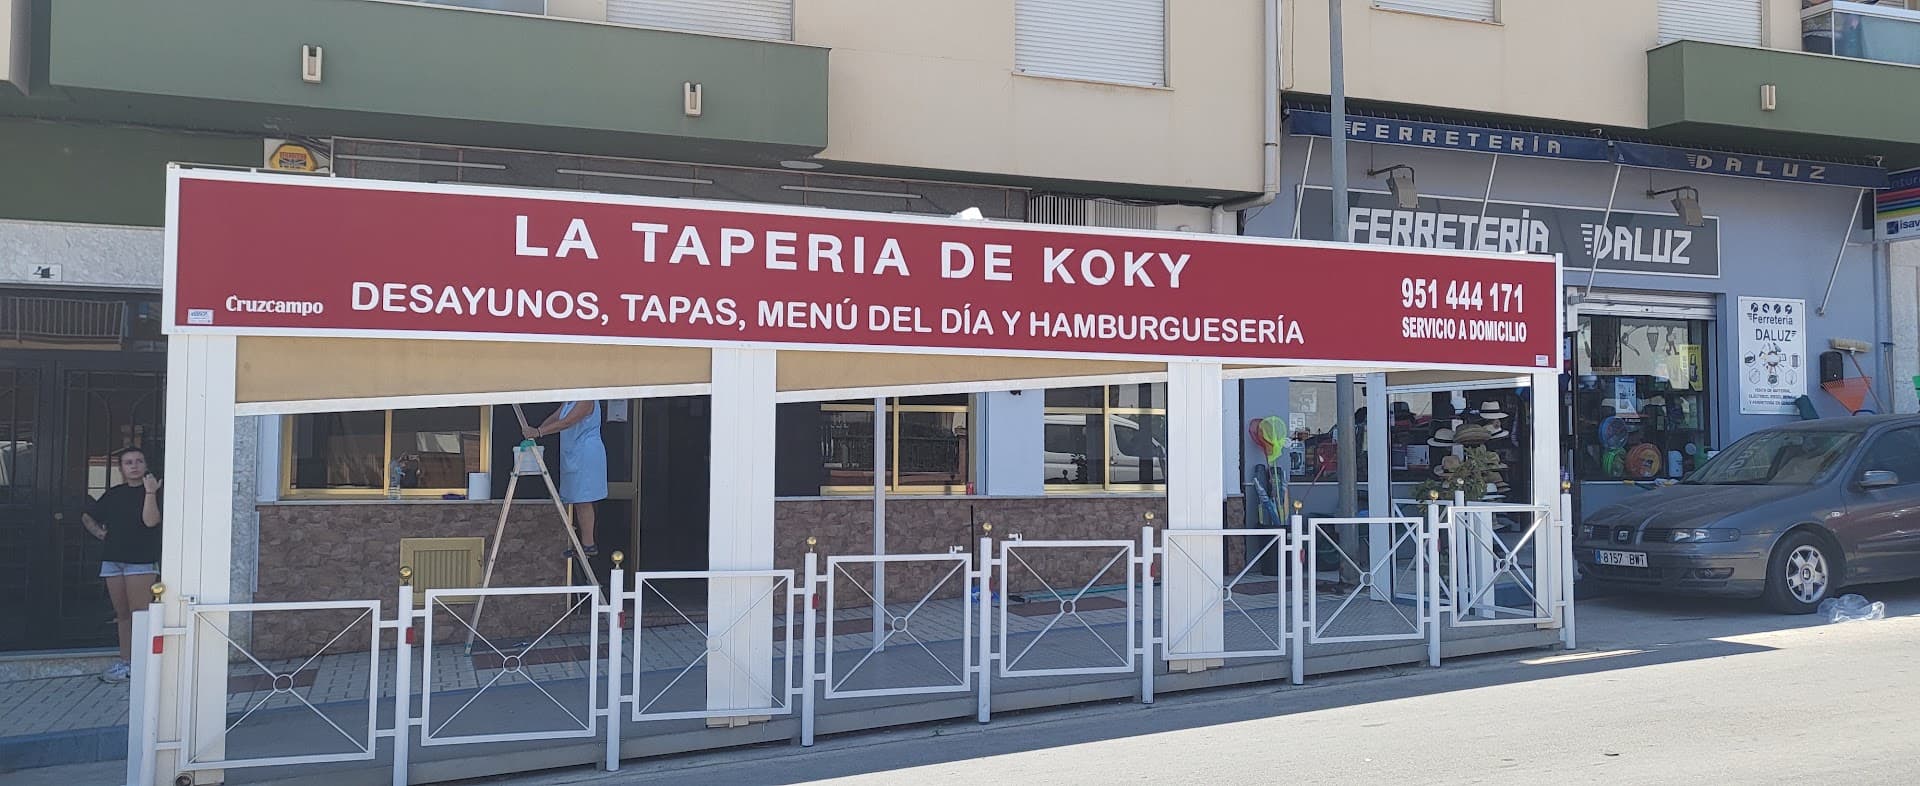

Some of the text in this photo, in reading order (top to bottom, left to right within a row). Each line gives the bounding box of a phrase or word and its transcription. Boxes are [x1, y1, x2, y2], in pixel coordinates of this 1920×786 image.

[1696, 155, 1826, 180] DALUZ
[515, 215, 1191, 289] LA TAPERIA DE KOKY
[1592, 224, 1692, 265] DALUZ
[225, 295, 324, 316] Cruzcampo
[1401, 277, 1523, 313] 951 444 171
[351, 281, 1305, 346] DESAYUNOS, TAPAS, MENÚ DEL DÍA Y HAMBURGUESERÍA
[1401, 316, 1527, 343] SERVICIO A DOMICILIO
[1755, 328, 1792, 342] DALUZ
[1603, 552, 1645, 566] 8157 BWT
